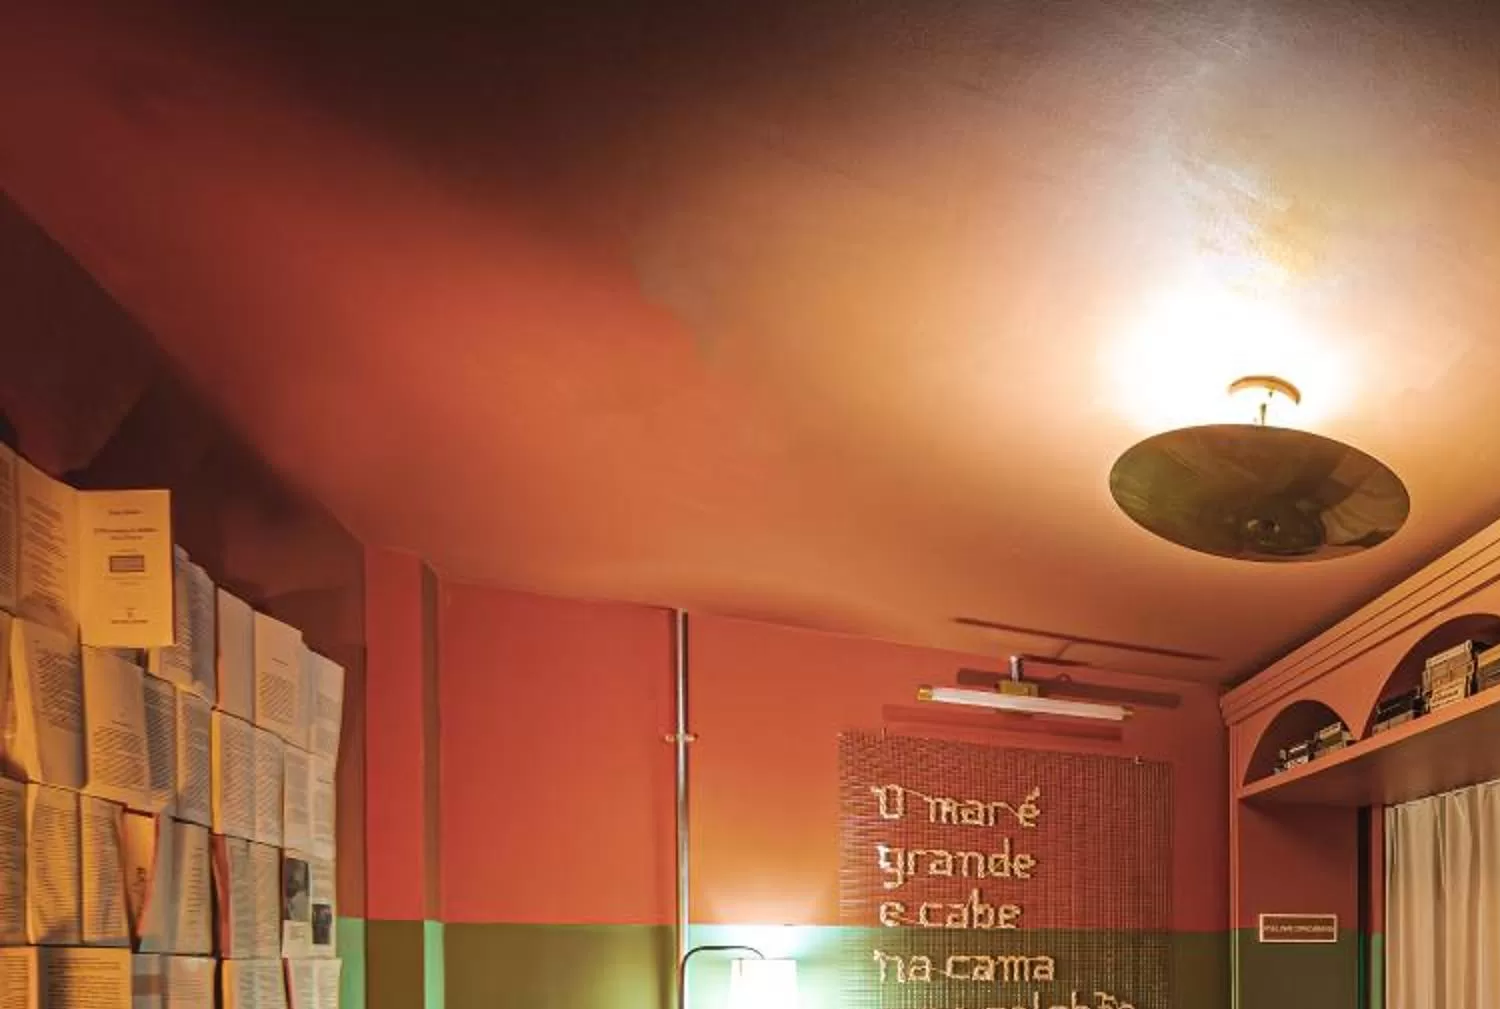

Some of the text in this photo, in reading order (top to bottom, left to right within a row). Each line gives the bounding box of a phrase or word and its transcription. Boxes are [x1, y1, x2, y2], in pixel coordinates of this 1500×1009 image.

[923, 797, 1004, 827] mar
[1017, 786, 1041, 827] é
[877, 837, 1037, 889] grande
[879, 888, 1022, 929] e cabe
[873, 949, 1055, 983] na cama
